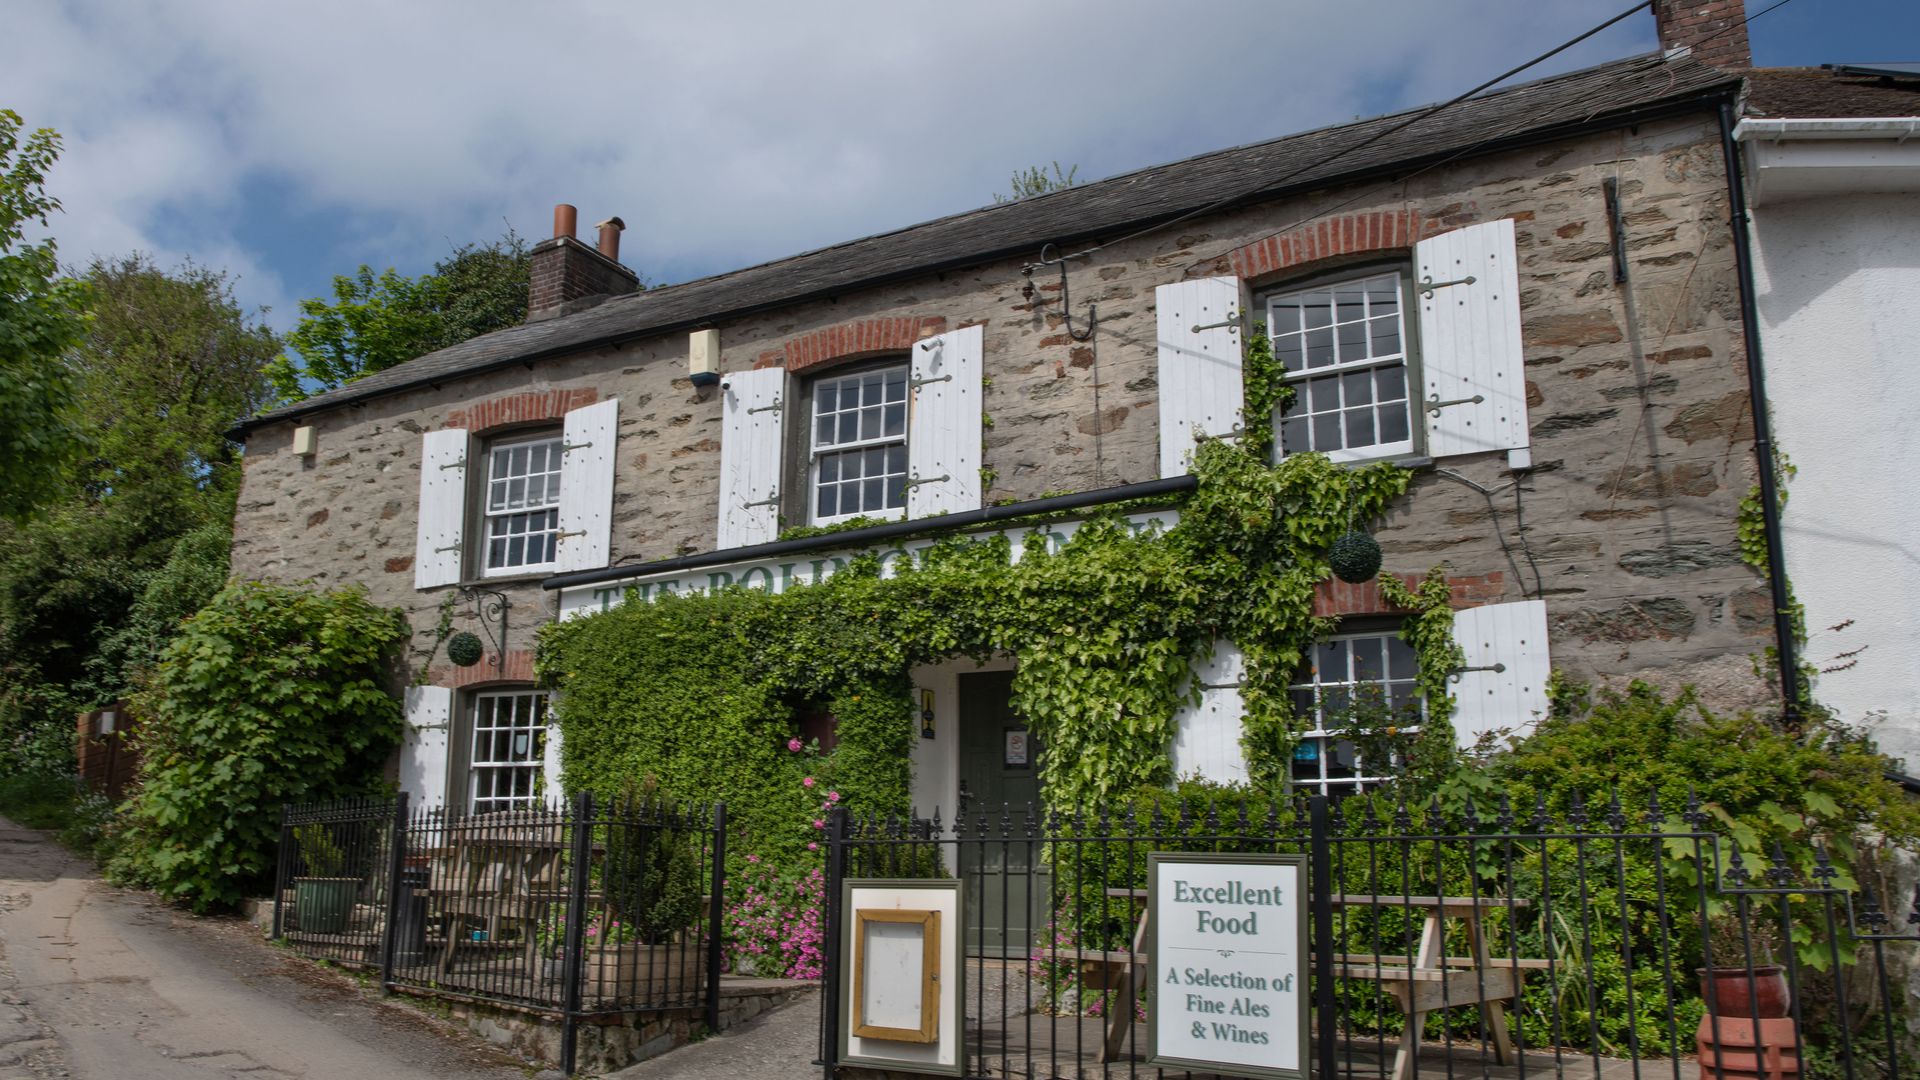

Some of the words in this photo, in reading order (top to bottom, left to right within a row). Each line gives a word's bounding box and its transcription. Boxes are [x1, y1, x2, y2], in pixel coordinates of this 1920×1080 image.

[1173, 880, 1283, 906] Excellent
[1197, 910, 1258, 935] Food
[1166, 967, 1181, 985] A
[1184, 967, 1268, 991] Selection
[1271, 973, 1294, 993] of
[1186, 994, 1225, 1014] Fine
[1229, 998, 1270, 1018] Ales
[1191, 1021, 1207, 1040] &
[1211, 1022, 1269, 1045] Wines
